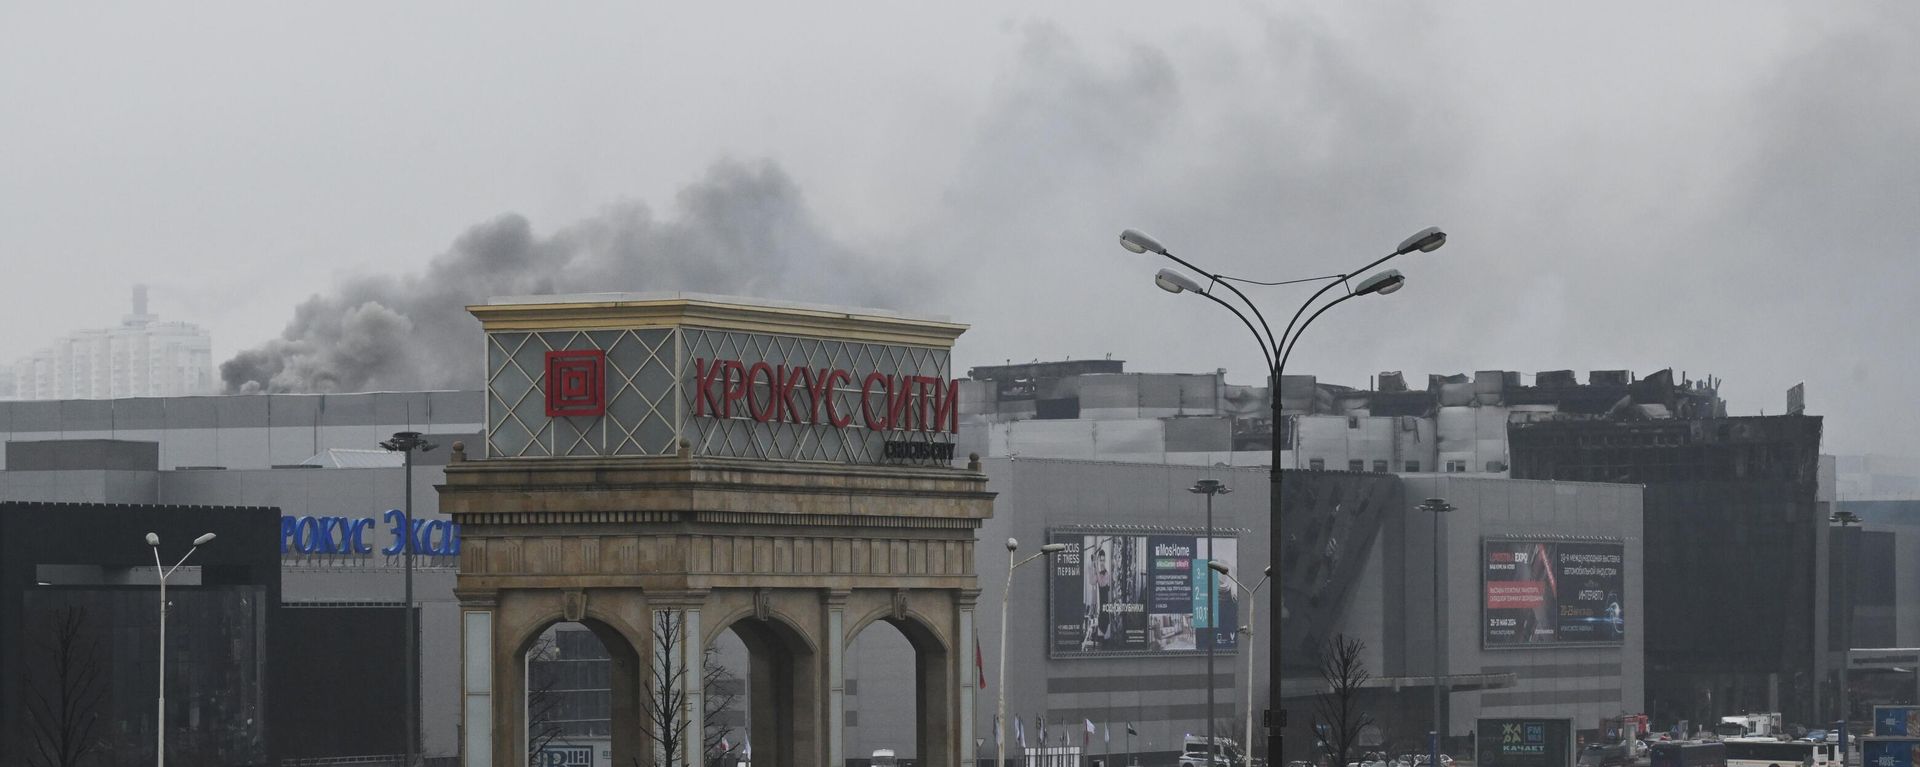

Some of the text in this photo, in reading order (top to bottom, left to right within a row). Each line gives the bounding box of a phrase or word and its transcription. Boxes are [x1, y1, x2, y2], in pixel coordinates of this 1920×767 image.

[695, 358, 959, 434] КРОКУС СИТИ
[1057, 565, 1080, 576] ПЕРВЫЙ
